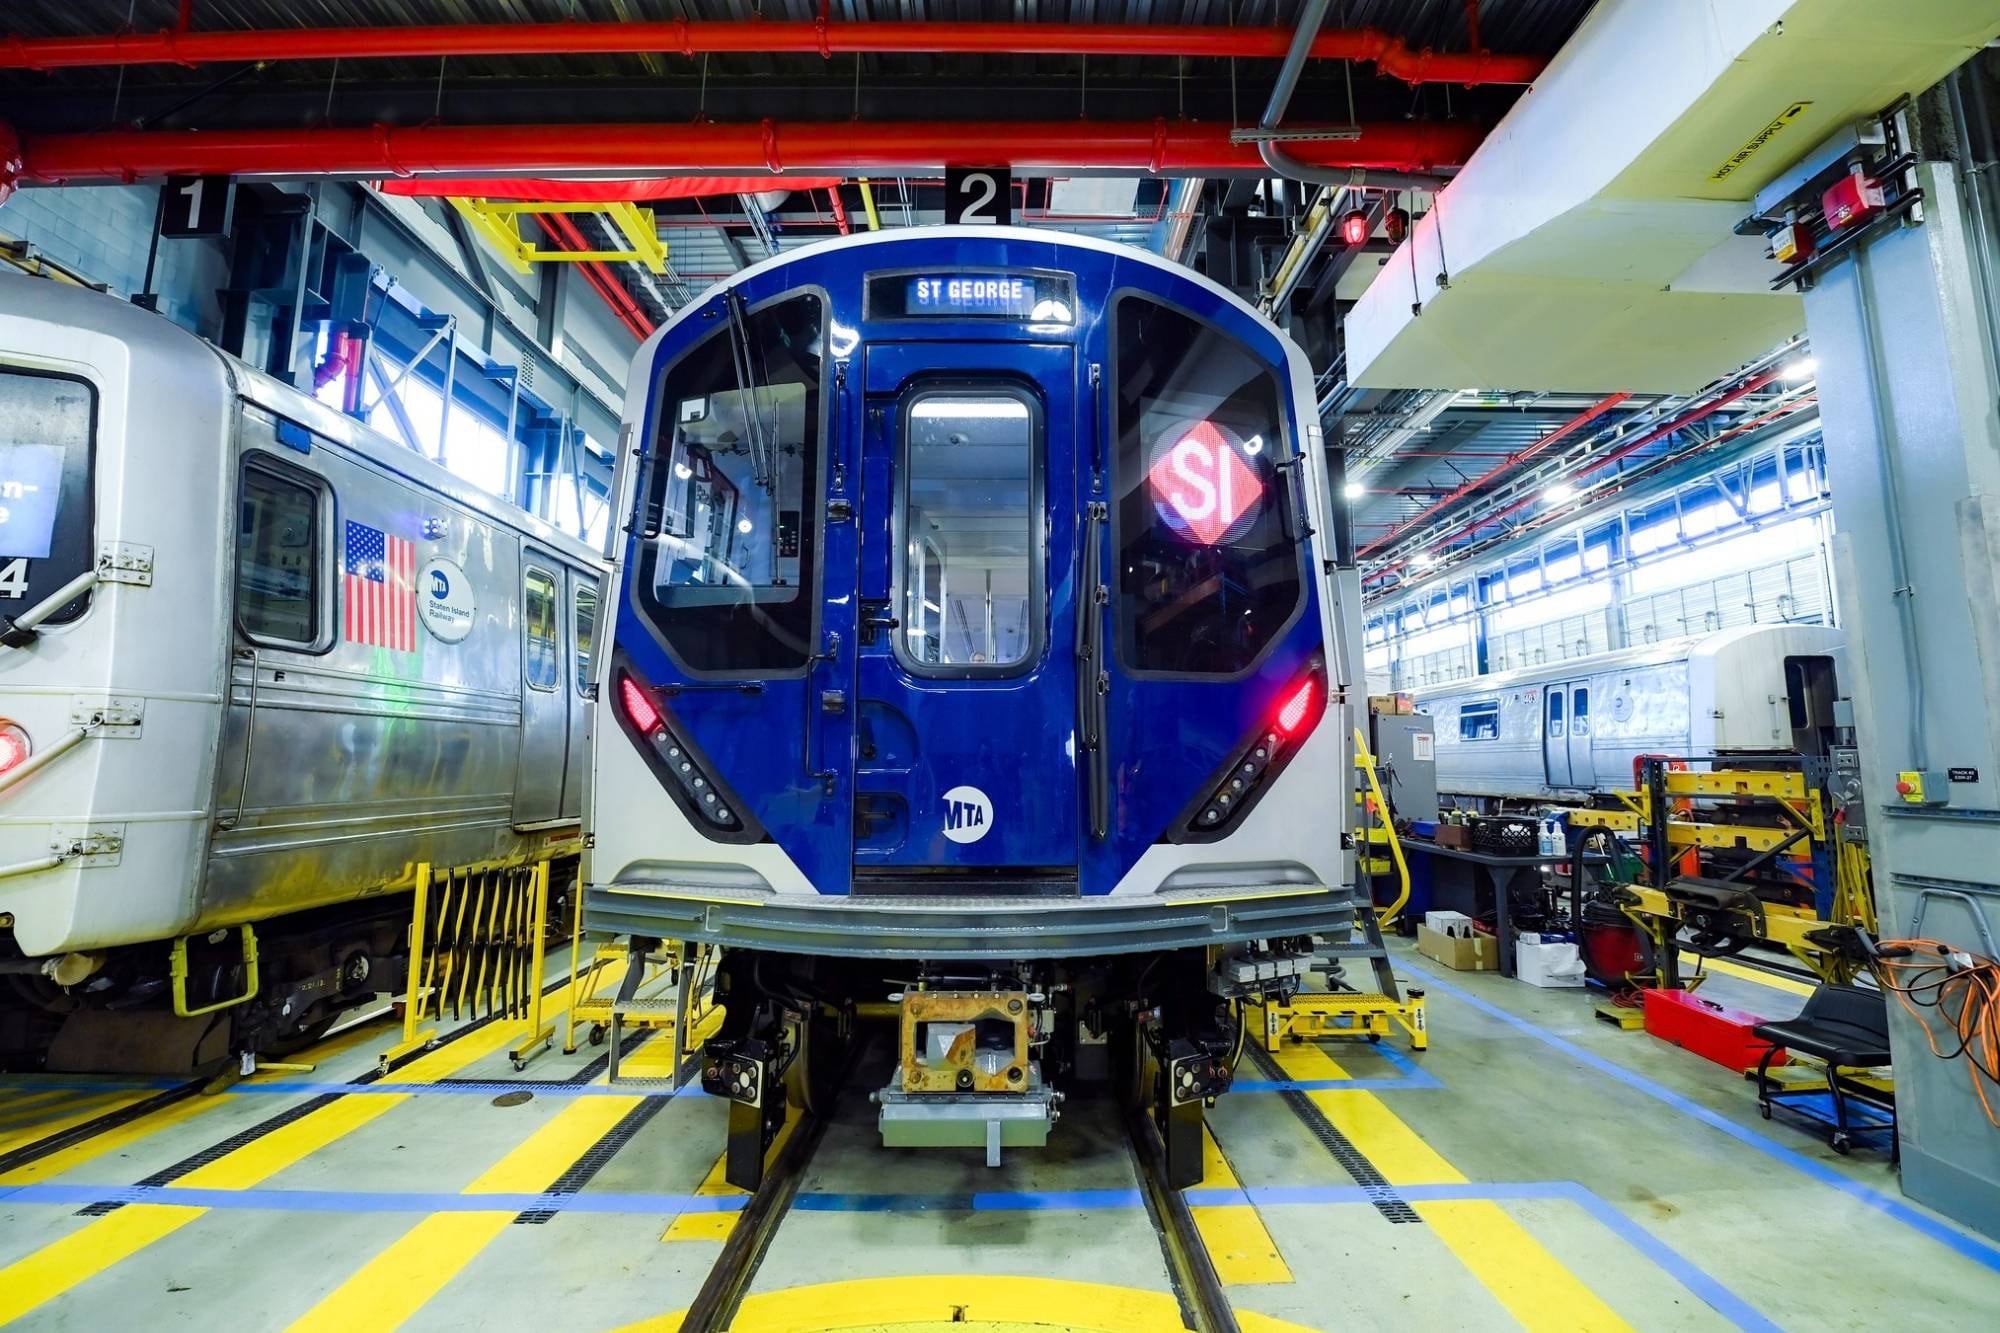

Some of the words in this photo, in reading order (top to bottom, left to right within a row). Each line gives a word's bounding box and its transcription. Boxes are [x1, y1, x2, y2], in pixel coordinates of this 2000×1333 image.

[1712, 164, 1735, 179] HOT
[1732, 150, 1753, 163] AIR
[1747, 121, 1785, 150] SUPPLY
[180, 179, 204, 229] 1
[959, 173, 997, 224] 2
[918, 280, 942, 299] ST
[948, 280, 1023, 299] GEORGE
[1171, 439, 1232, 523] SI
[0, 558, 29, 599] 4
[429, 599, 451, 613] Staten
[451, 606, 470, 618] Island
[429, 609, 455, 624] Railway
[274, 670, 286, 682] F
[944, 798, 984, 831] MTA
